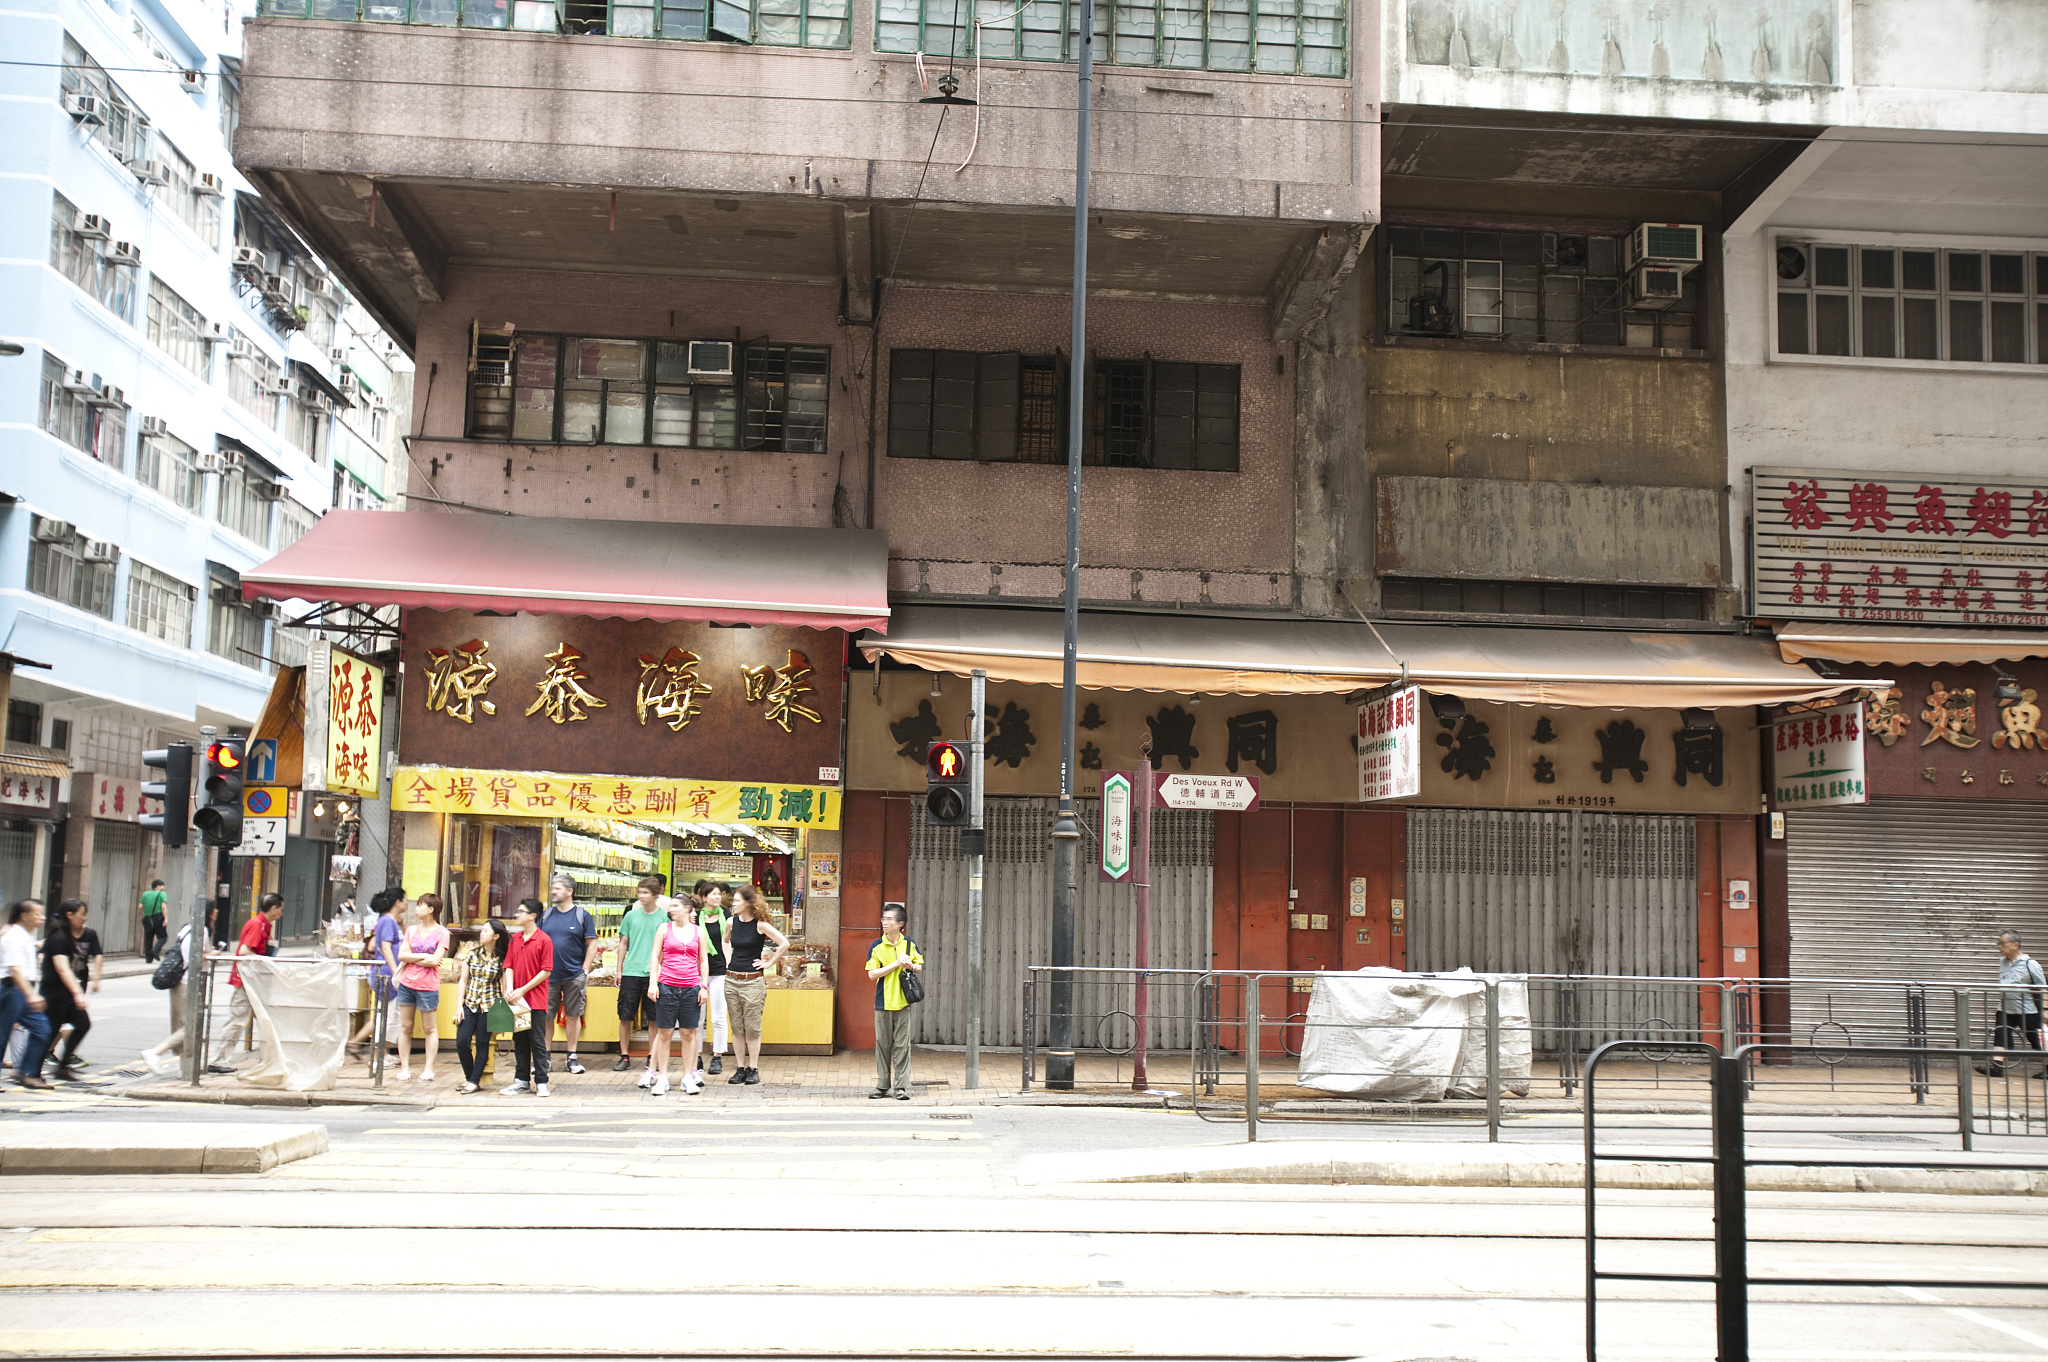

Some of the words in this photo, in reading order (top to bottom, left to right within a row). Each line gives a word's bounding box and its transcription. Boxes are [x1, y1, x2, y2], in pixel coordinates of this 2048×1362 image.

[1777, 536, 1809, 553] YUE
[1826, 540, 1866, 555] HING
[1881, 541, 1944, 558] MARINE
[1866, 565, 1909, 585] 魚翅
[1940, 568, 1984, 587] 魚肚
[2020, 592, 2048, 611] 進
[1862, 610, 1892, 620] 2559
[1896, 611, 1923, 621] 8510
[423, 637, 822, 733] 源泰海味
[1172, 777, 1188, 785] Des
[1192, 778, 1217, 787] Voeux
[1221, 779, 1232, 787] Rd
[404, 775, 717, 820] 全場貨品優惠酬賓
[738, 786, 826, 823] 勁減!
[1180, 788, 1235, 799] 德輔道西
[267, 821, 276, 833] 7
[1111, 816, 1123, 855] 海味街
[266, 841, 275, 853] 7
